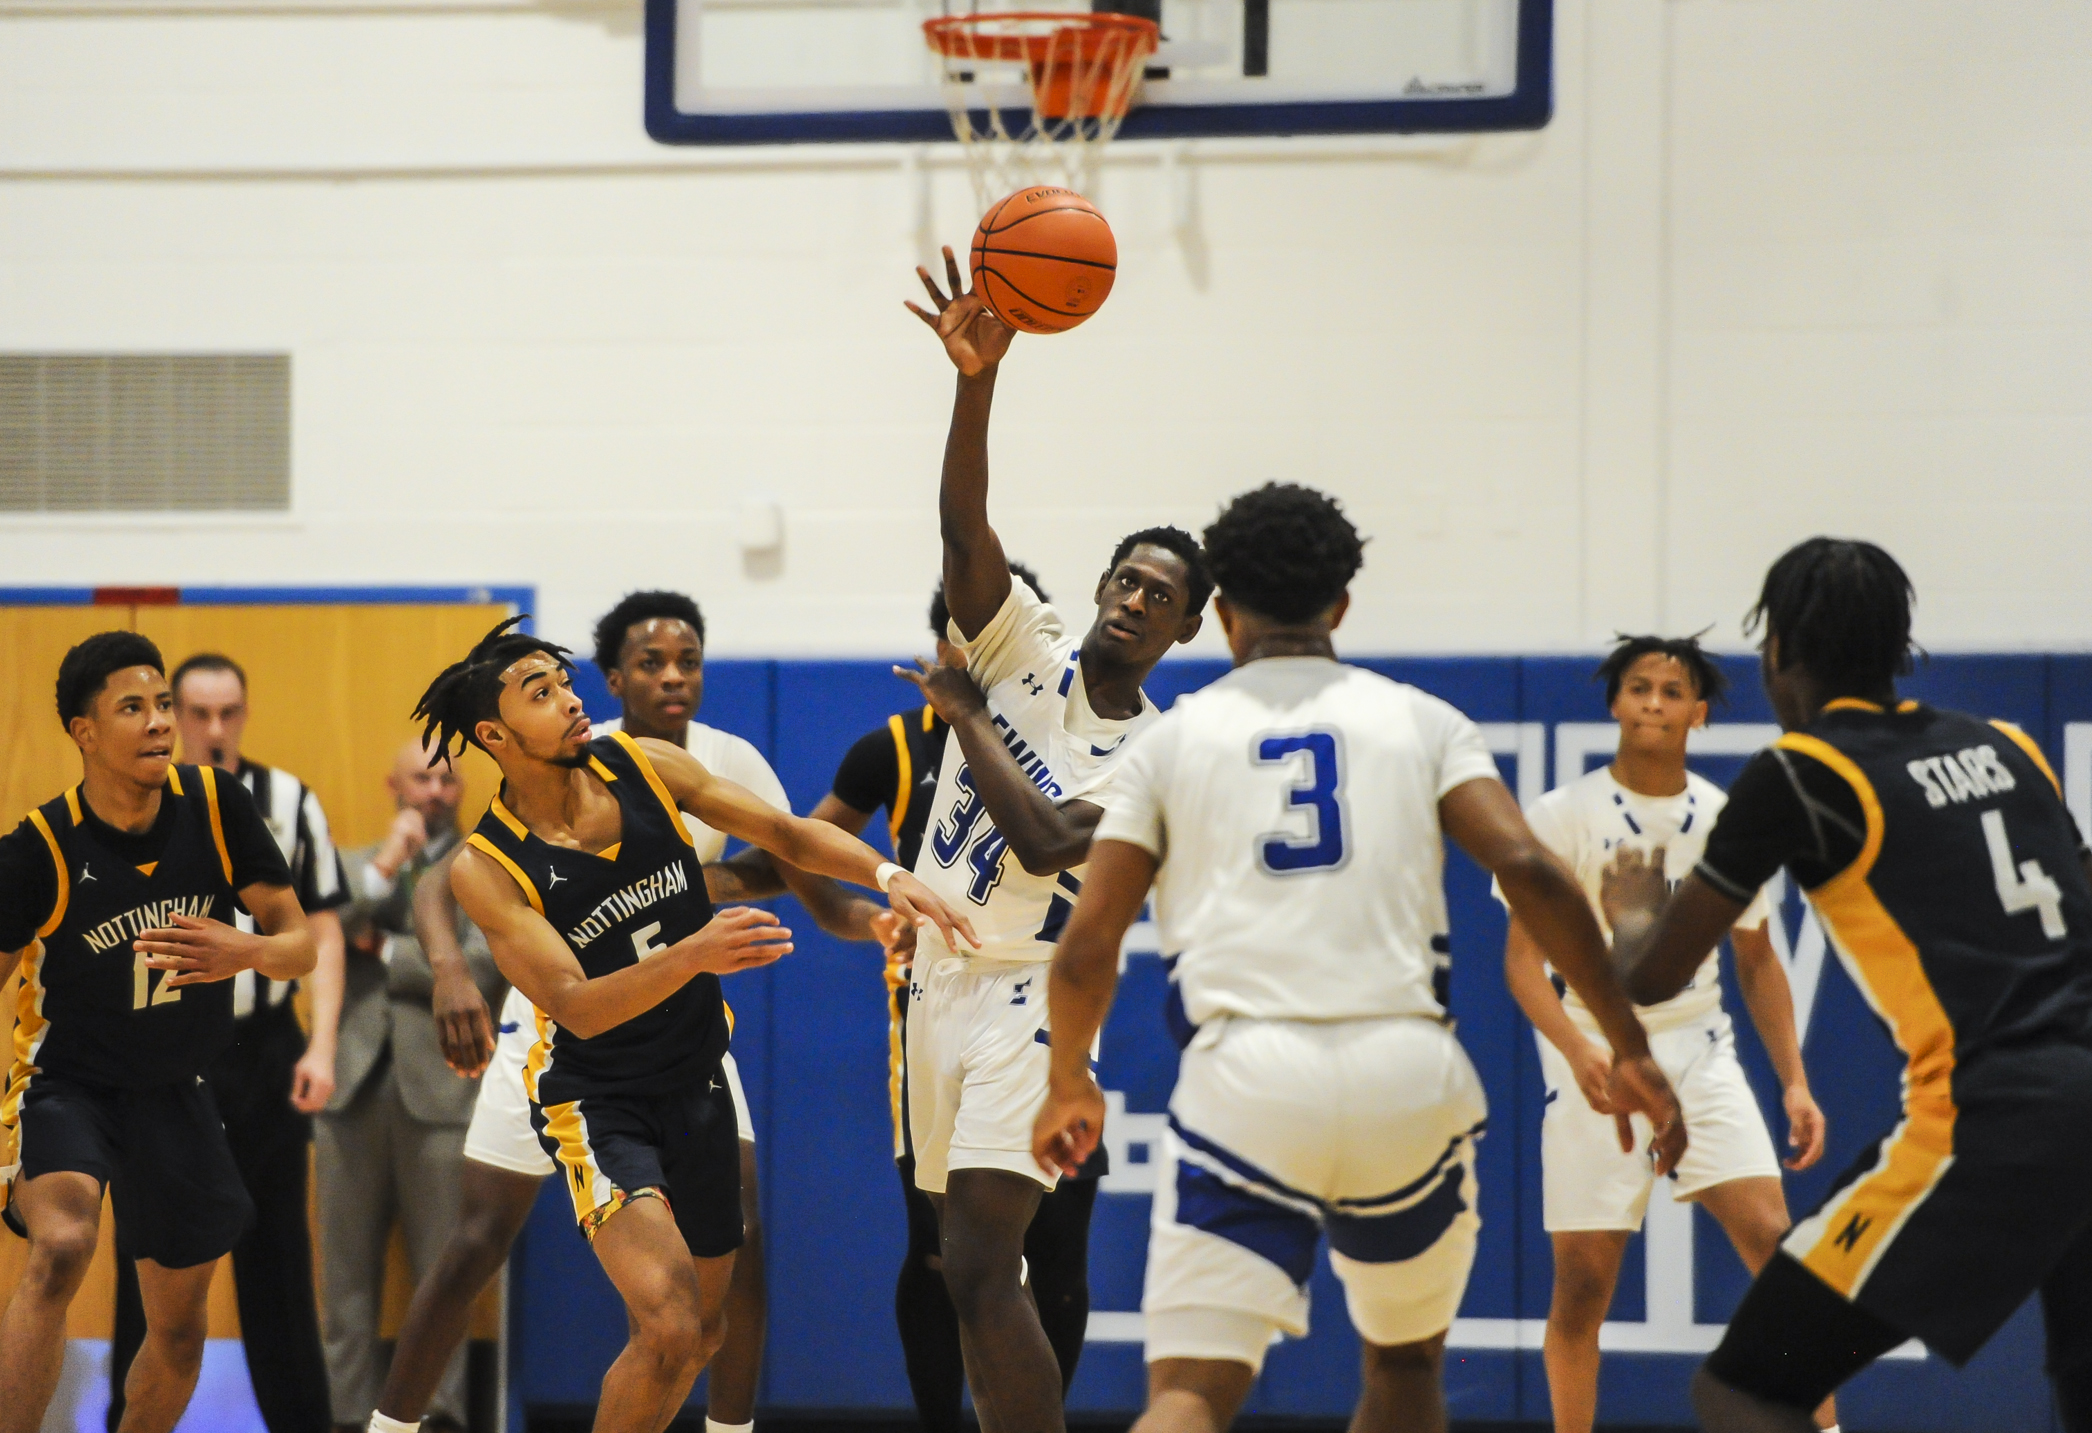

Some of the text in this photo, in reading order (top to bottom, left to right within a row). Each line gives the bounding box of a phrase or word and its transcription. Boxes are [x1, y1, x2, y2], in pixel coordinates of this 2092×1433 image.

[1251, 725, 1352, 876] 3
[1906, 745, 2016, 809] STARS
[931, 761, 1010, 906] 34
[1980, 808, 2068, 941] 4
[567, 859, 688, 949] NOTTINGHAM
[133, 951, 181, 1010] 12
